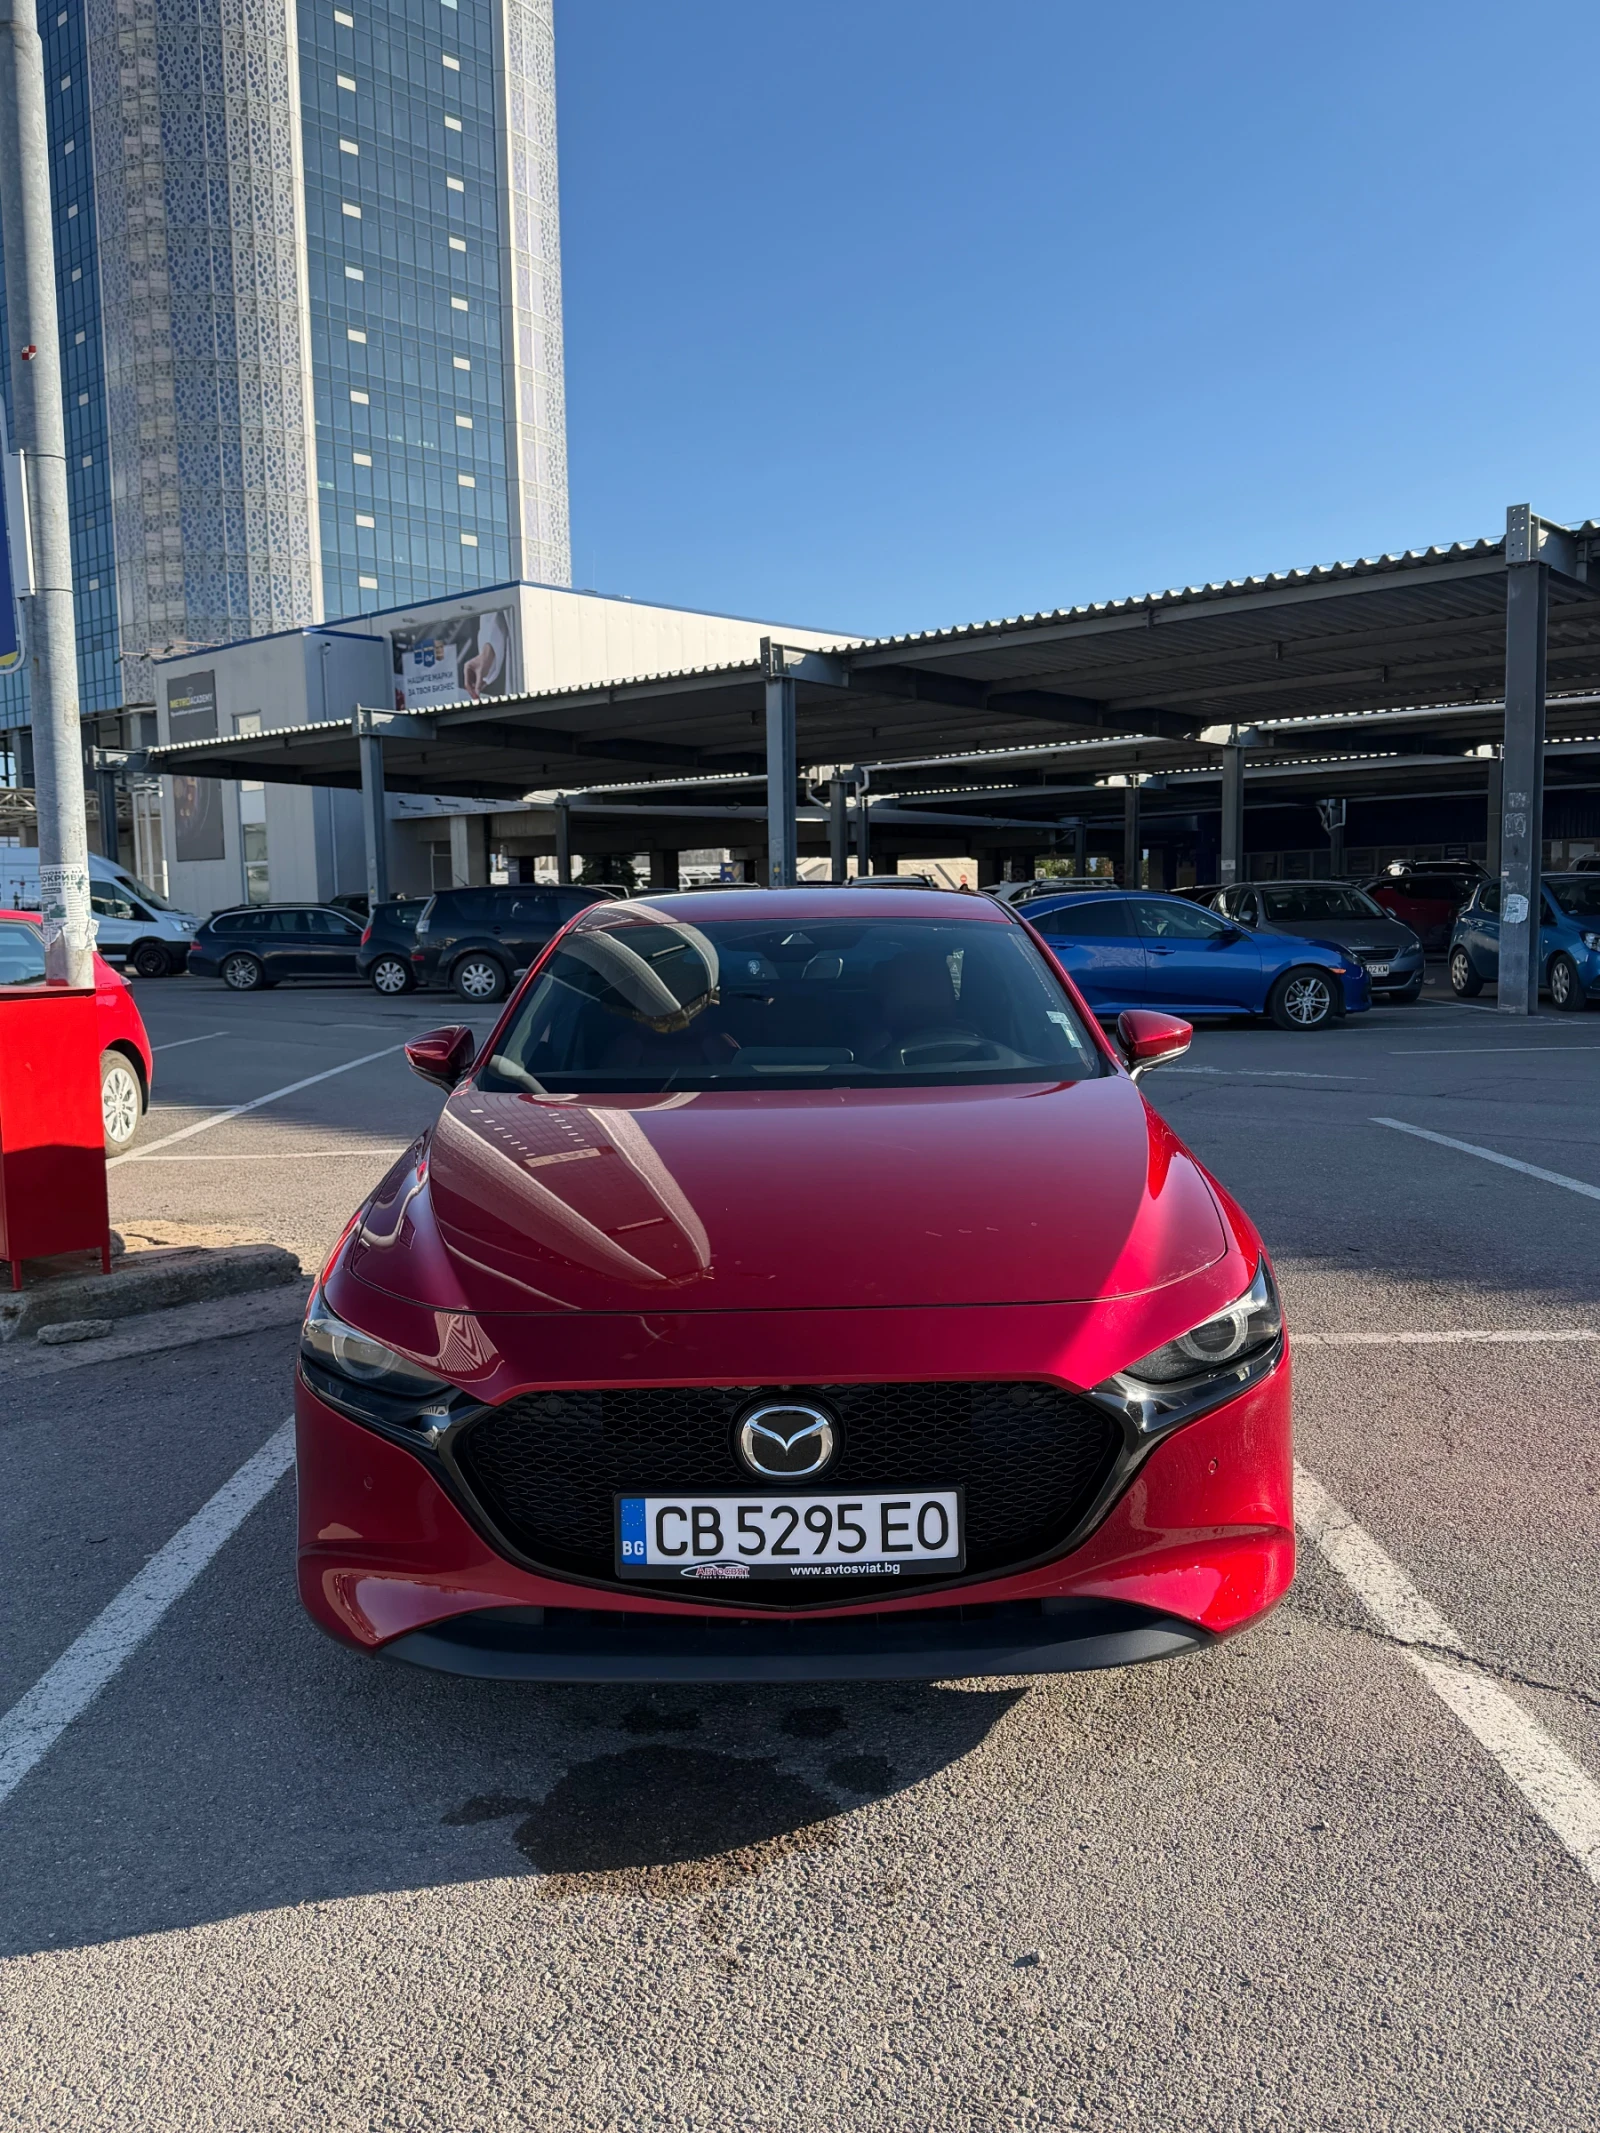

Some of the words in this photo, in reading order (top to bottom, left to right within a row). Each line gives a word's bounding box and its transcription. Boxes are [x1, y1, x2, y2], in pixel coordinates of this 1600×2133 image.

[655, 1505, 724, 1557] CB
[737, 1503, 867, 1556] 5295
[880, 1500, 949, 1553] EO
[622, 1540, 645, 1556] BG
[790, 1561, 900, 1576] www.avtosviat.bg
